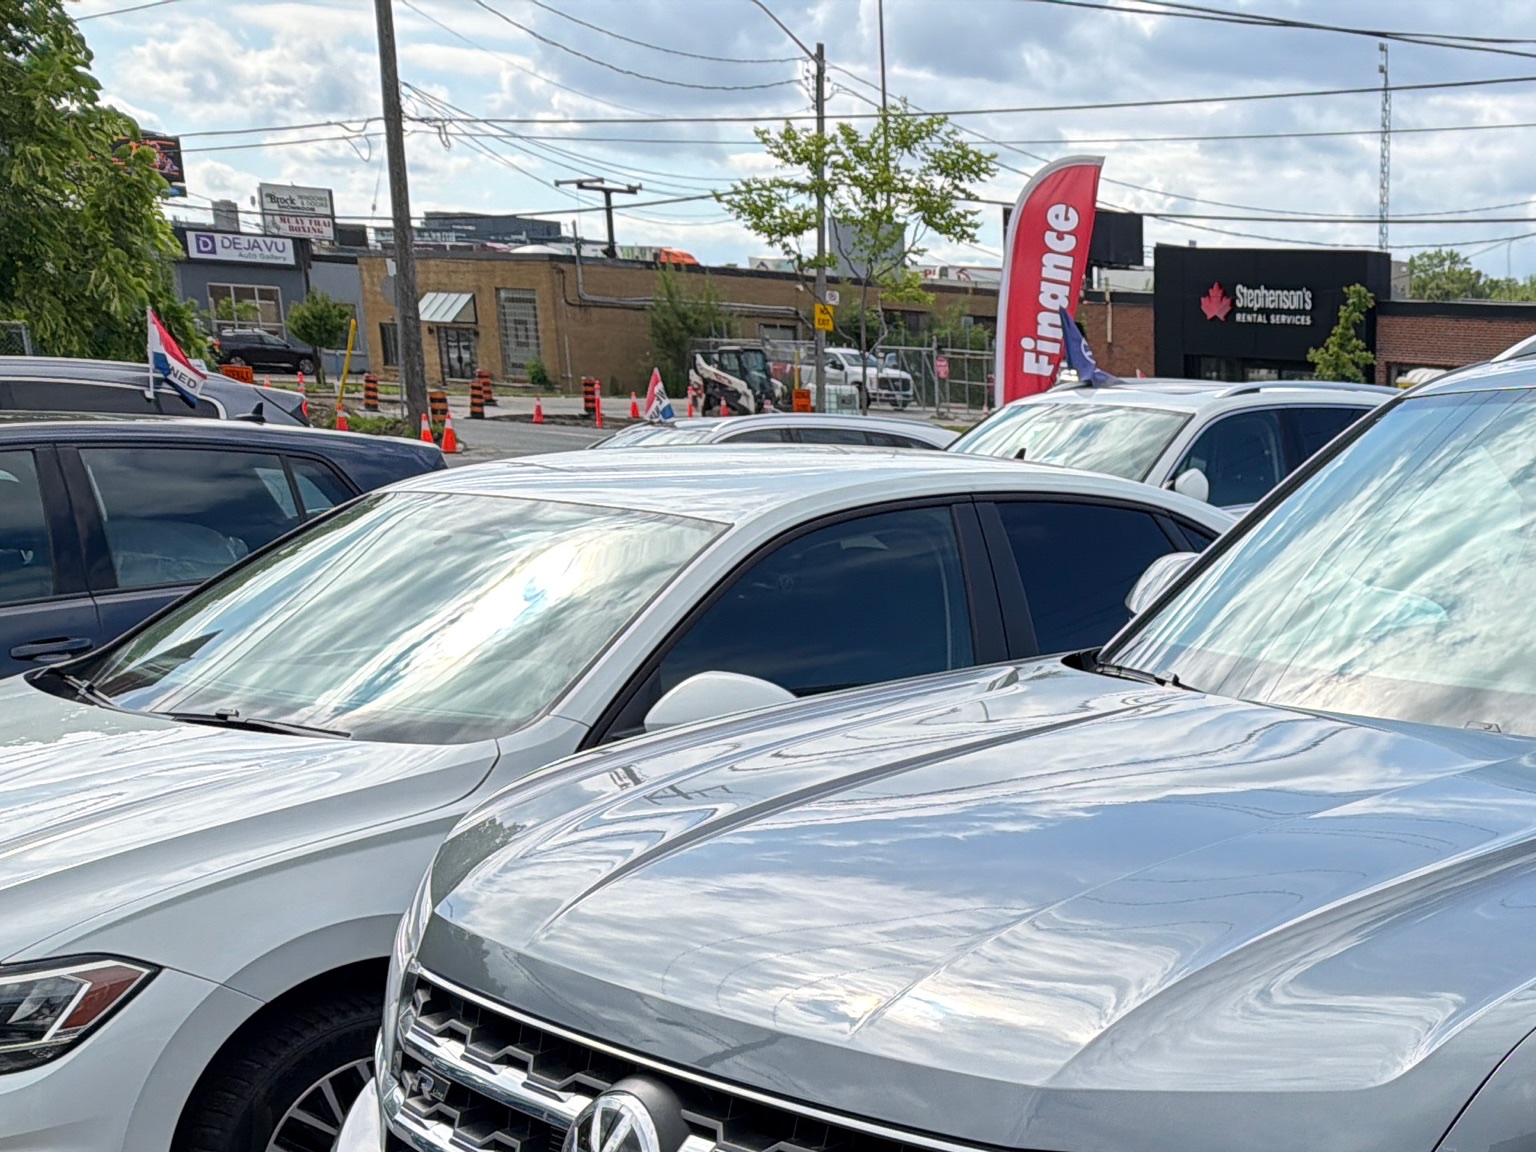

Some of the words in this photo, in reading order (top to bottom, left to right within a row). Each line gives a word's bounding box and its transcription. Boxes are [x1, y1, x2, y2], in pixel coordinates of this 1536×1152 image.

[270, 194, 296, 205] Brock
[279, 216, 305, 225] MUAY
[308, 219, 331, 228] THAI
[288, 225, 324, 235] BOXING
[259, 253, 287, 262] Gallery
[1020, 203, 1079, 377] Finance
[1235, 284, 1312, 312] Stephenson's
[1235, 313, 1268, 324] RENTAL
[1270, 314, 1312, 325] SERVICES
[168, 363, 198, 390] NED
